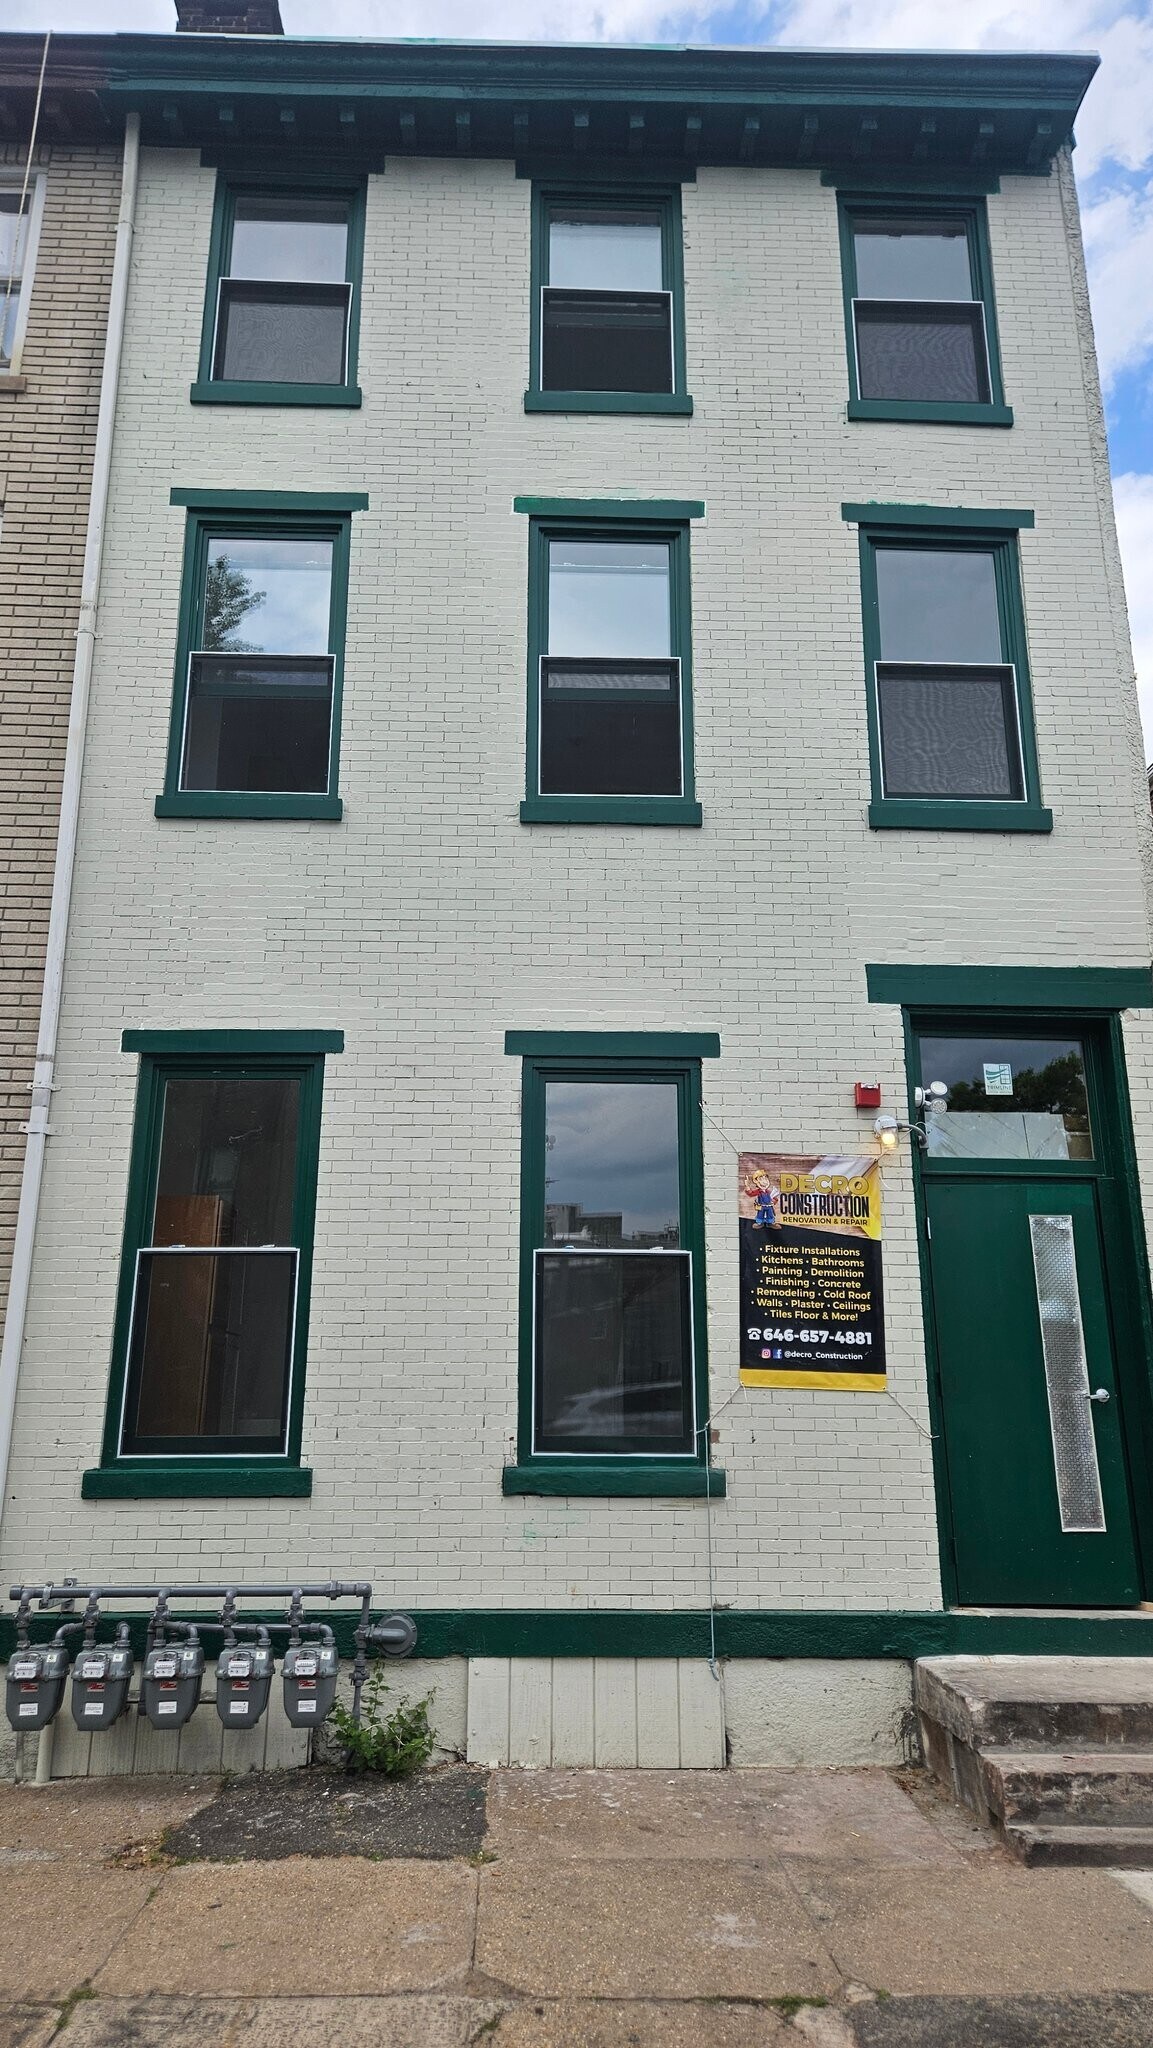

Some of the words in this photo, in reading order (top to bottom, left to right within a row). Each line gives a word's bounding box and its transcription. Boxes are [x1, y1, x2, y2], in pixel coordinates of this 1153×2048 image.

[780, 1173, 869, 1195] DECRO
[780, 1193, 869, 1218] CONSTRUCTION
[765, 1245, 799, 1254] Fixture
[802, 1246, 860, 1256] Installations
[761, 1256, 803, 1264] Kitchens
[812, 1258, 865, 1267] Bathrooms
[762, 1266, 802, 1277] Painting
[811, 1268, 864, 1278] Demolition
[766, 1277, 809, 1287] Finishing
[818, 1280, 861, 1288] Concrete
[757, 1288, 815, 1298] Remodeling
[824, 1290, 845, 1299] Cold
[848, 1292, 871, 1300] Roof
[757, 1298, 782, 1307] Walls
[791, 1300, 824, 1308] Plaster
[833, 1302, 871, 1312] Ceilings
[770, 1310, 792, 1318] Tiles
[795, 1311, 819, 1320] Floor
[822, 1312, 829, 1320] &
[832, 1313, 858, 1321] More!
[763, 1328, 872, 1345] 646-657-4881
[784, 1351, 863, 1360] @decro_Construction
